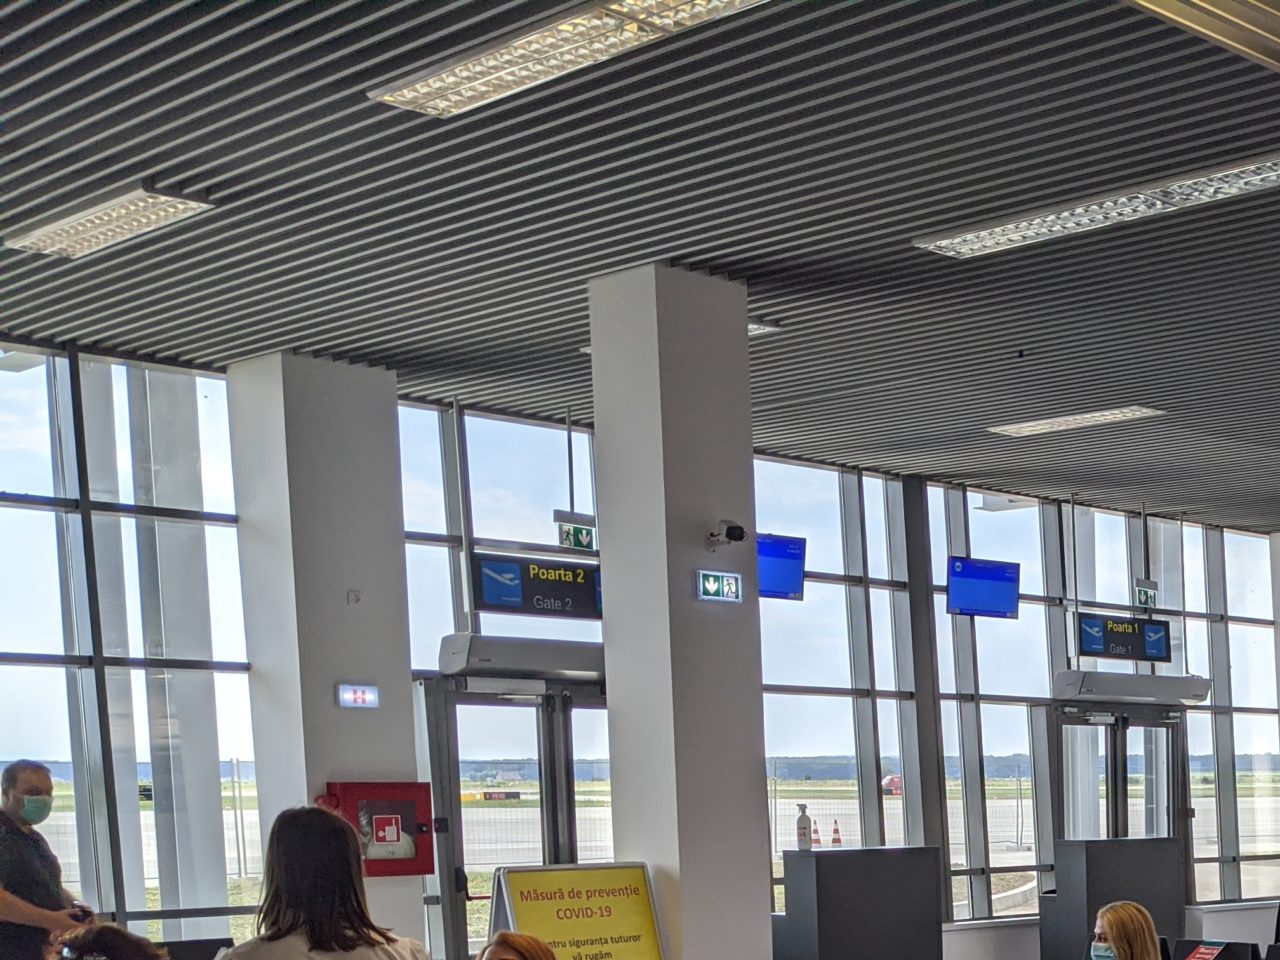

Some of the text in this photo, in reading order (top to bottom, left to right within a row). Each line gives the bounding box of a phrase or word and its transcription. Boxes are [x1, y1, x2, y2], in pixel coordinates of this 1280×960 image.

[530, 565, 584, 583] Poarta 2
[533, 595, 573, 611] Gate 2
[1107, 621, 1139, 633] Poarta 1
[1109, 643, 1132, 654] Gate 1
[520, 884, 640, 902] Măsură de prevenție
[556, 905, 612, 920] COVID-19
[548, 934, 641, 950] ntru siguranța tuturor
